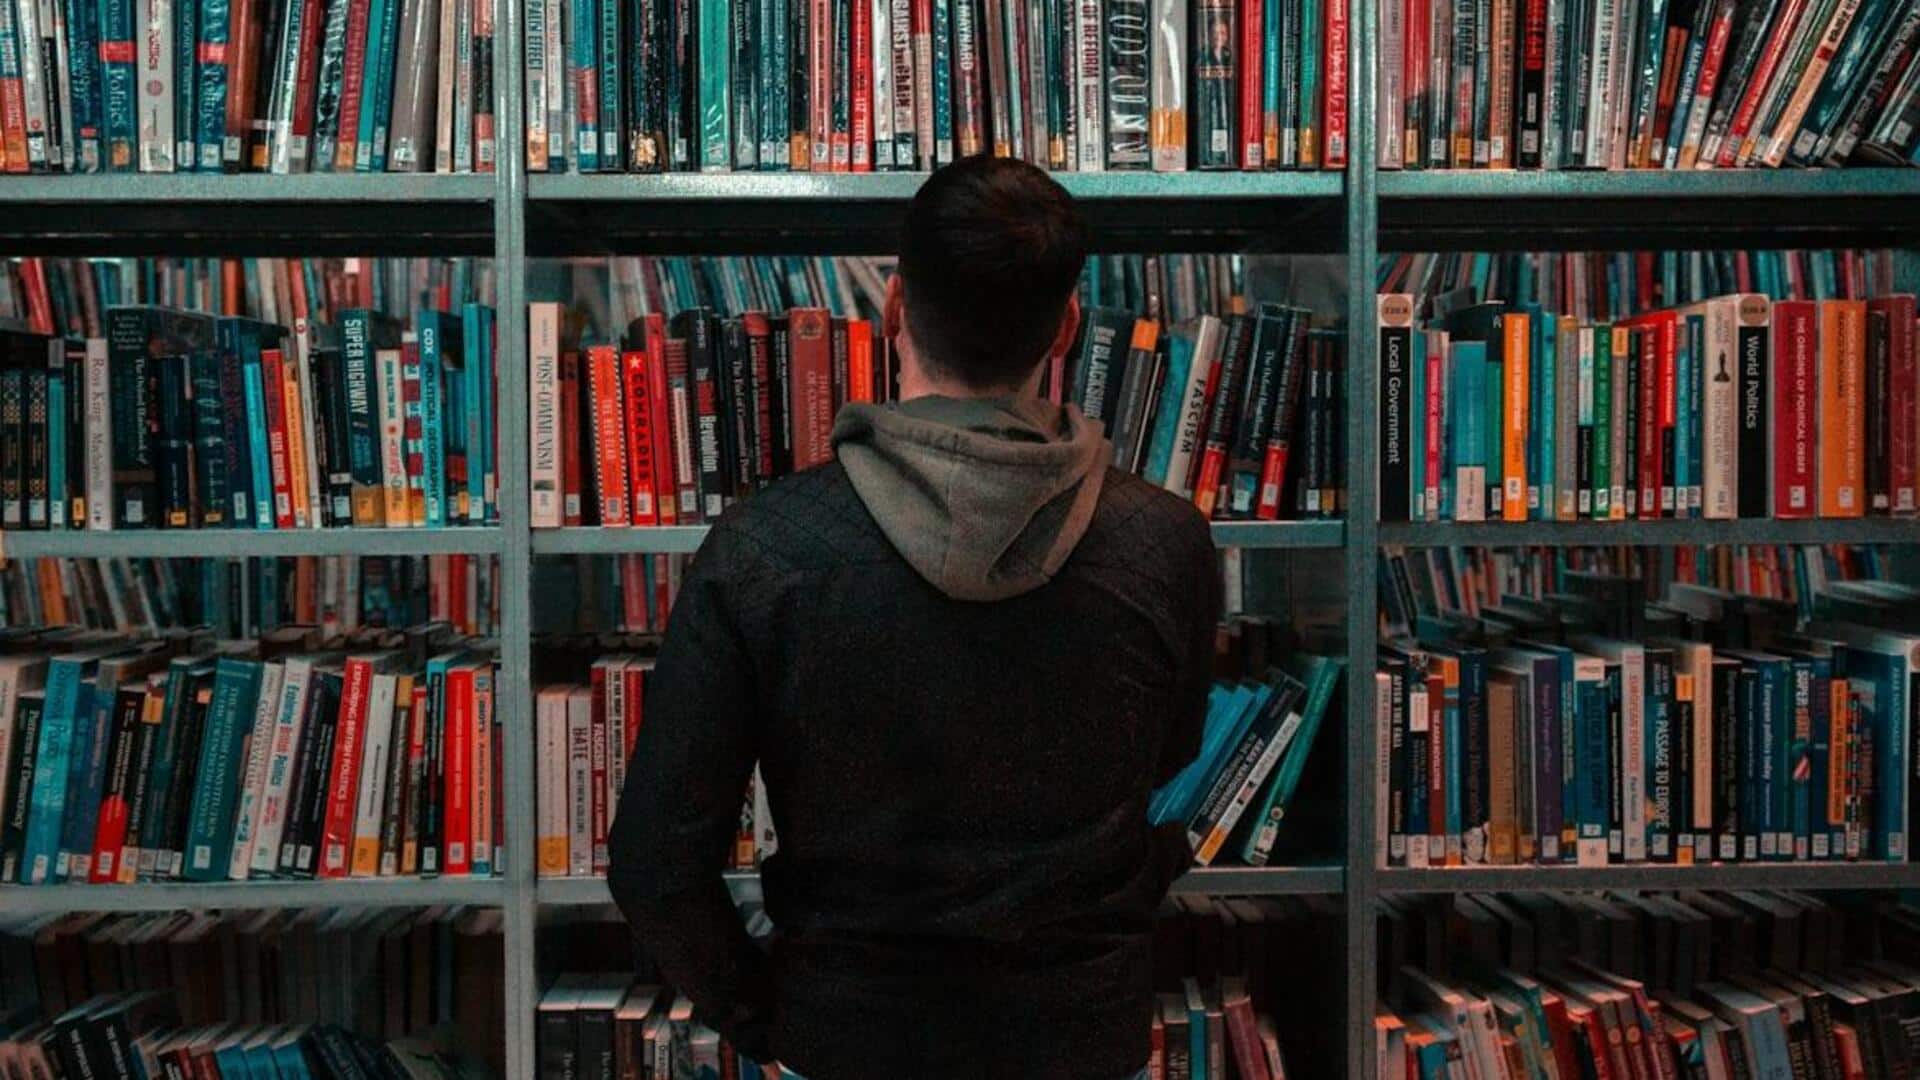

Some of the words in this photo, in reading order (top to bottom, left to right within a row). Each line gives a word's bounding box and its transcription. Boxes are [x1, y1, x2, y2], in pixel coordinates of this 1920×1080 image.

[528, 35, 544, 71] EFFECT
[959, 4, 973, 71] MAYNARD
[1081, 24, 1099, 78] REFORM
[1680, 42, 1703, 104] ANARCHISM
[109, 68, 128, 129] Politics
[203, 68, 222, 129] Politics
[345, 319, 364, 358] SUPER
[423, 328, 435, 355] COX
[1796, 316, 1806, 333] THE
[91, 358, 104, 387] Ross
[1388, 336, 1401, 373] Local
[1746, 336, 1759, 376] World
[1796, 335, 1806, 376] ORIGINS
[347, 359, 369, 414] HIGHWAY
[425, 362, 438, 423] POLITICAL
[1083, 344, 1112, 420] BLACKSHIR
[1796, 379, 1806, 391] OF
[1846, 387, 1856, 405] AND
[88, 391, 105, 423] King
[535, 355, 553, 471] POST-COMMUNISM
[808, 388, 819, 463] COMMUNISM
[1180, 379, 1207, 454] FASCISM
[1388, 376, 1401, 464] Government
[1745, 380, 1759, 429] Politics
[1796, 394, 1806, 440] POLITICAL
[633, 372, 650, 481] COMRADES
[700, 415, 718, 472] Revolution
[427, 428, 440, 500] GEOGRAPHY
[1796, 442, 1806, 474] ORDER
[281, 684, 299, 724] Exploring
[346, 663, 364, 718] EXPLORING
[1393, 675, 1403, 704] AFTER
[1629, 675, 1638, 727] EUROPEAN
[1761, 683, 1773, 722] European
[1796, 670, 1809, 706] SUPER
[23, 709, 39, 755] Patterns
[1393, 706, 1403, 724] THE
[342, 720, 358, 757] BRITISH
[573, 727, 588, 760] HATE
[592, 723, 605, 771] FASCISM
[1393, 726, 1403, 748] FALL
[1629, 729, 1639, 773] POLITICS
[1655, 719, 1668, 768] PASSAGE
[1761, 723, 1773, 754] politics
[21, 756, 33, 768] of
[270, 755, 289, 787] Politics
[336, 759, 353, 801] POLITICS
[1655, 770, 1668, 783] TO
[1761, 755, 1773, 780] today
[12, 768, 31, 830] Democracy
[207, 755, 230, 839] CONSTITUTION
[1655, 785, 1669, 828] EUROPE
